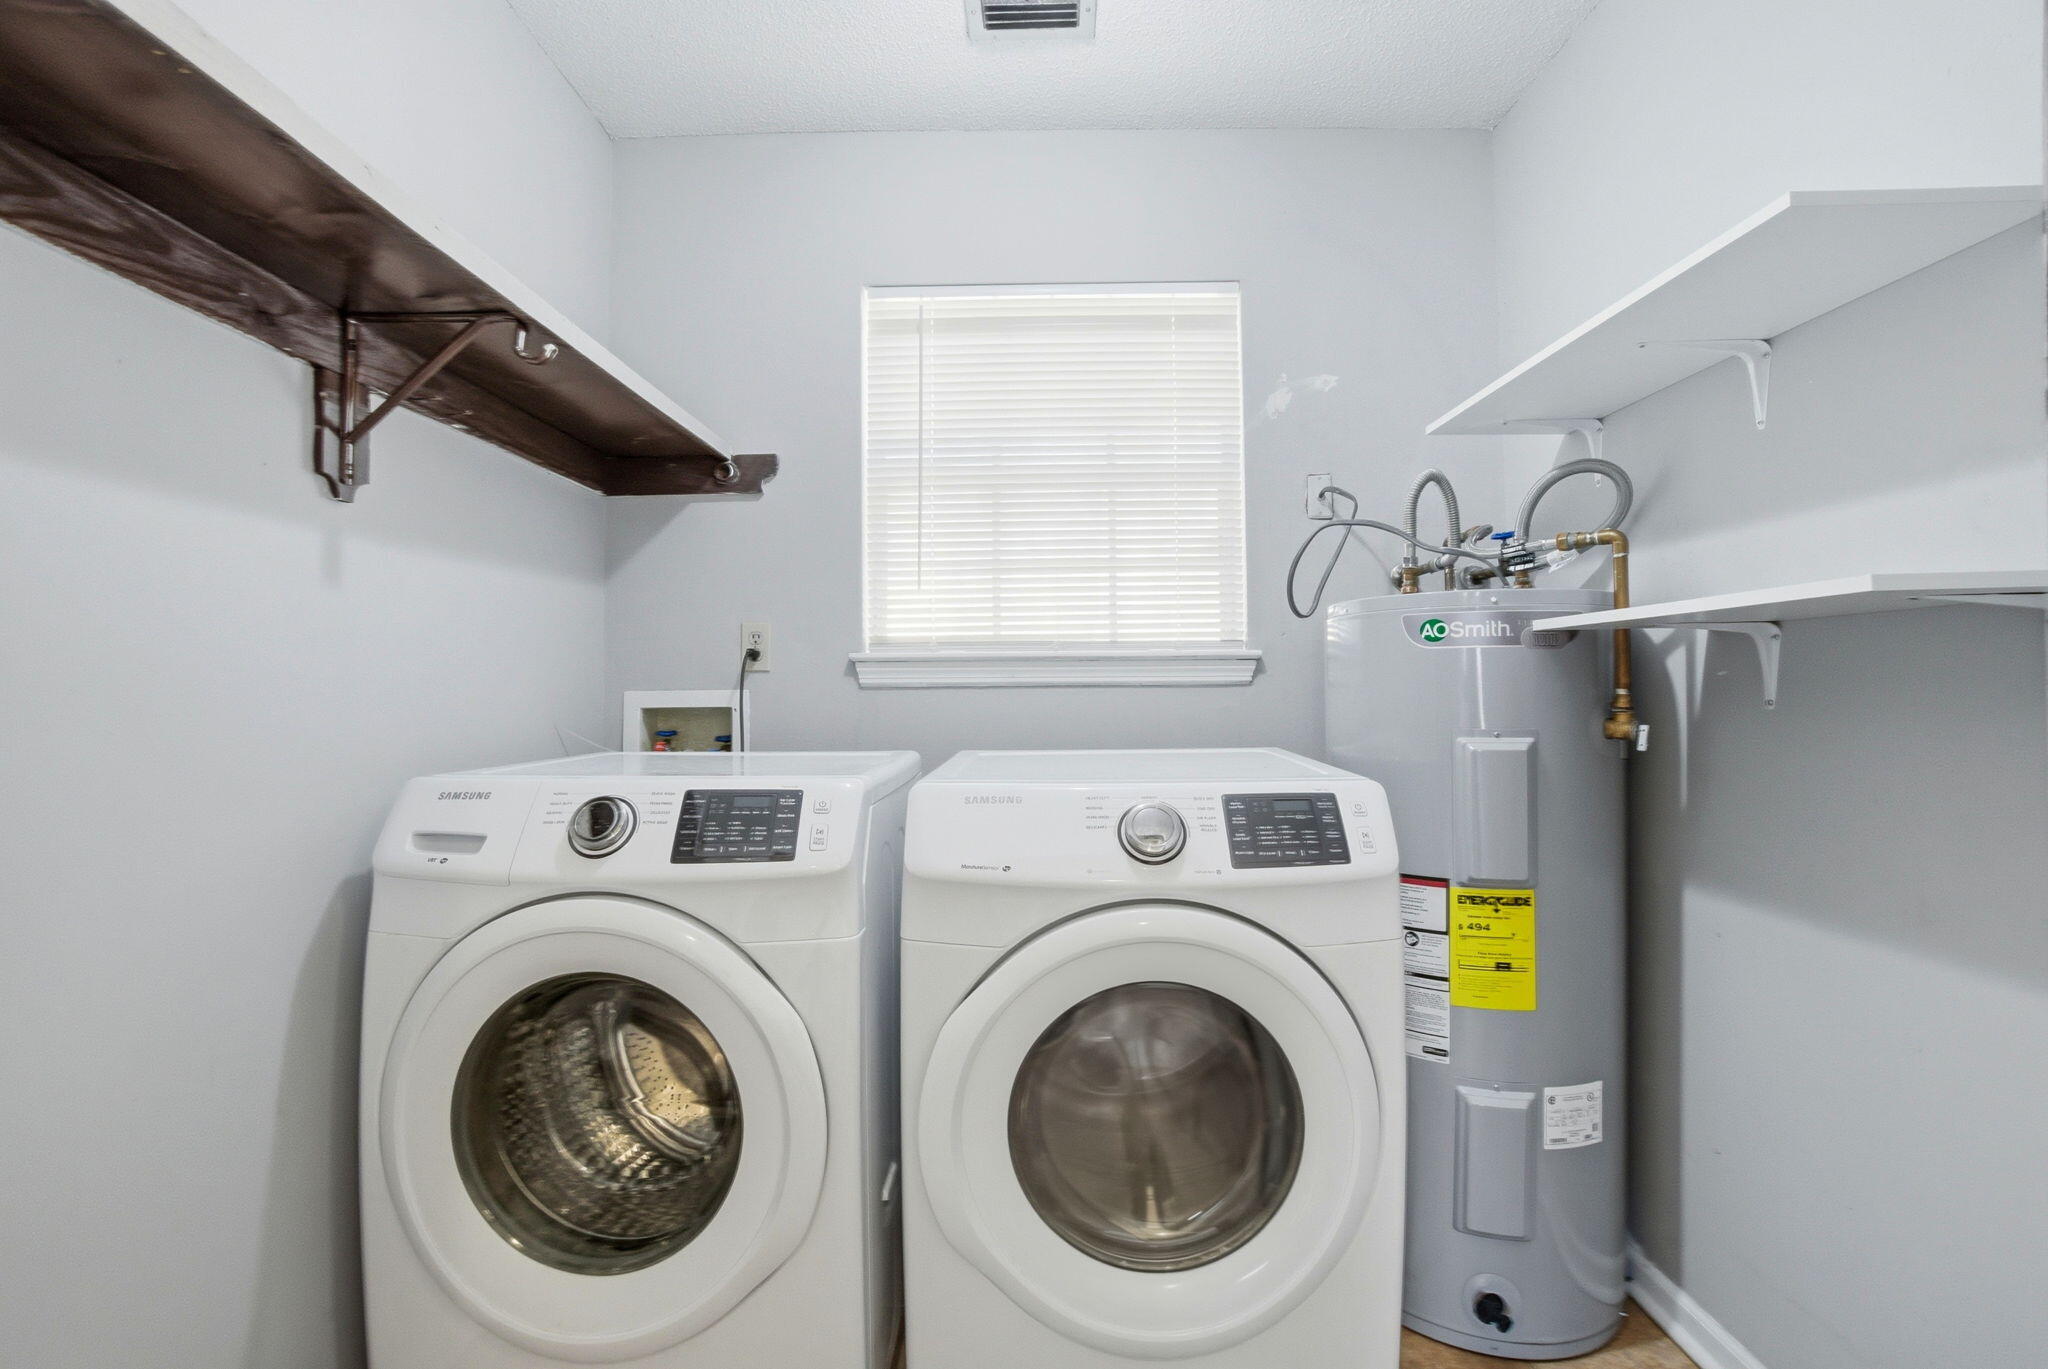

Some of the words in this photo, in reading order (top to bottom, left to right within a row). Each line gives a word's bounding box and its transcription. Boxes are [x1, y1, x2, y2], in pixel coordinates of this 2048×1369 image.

[437, 791, 492, 800] SAMSUNG
[963, 795, 1023, 805] SAMSUNG
[1466, 922, 1491, 931] 494
